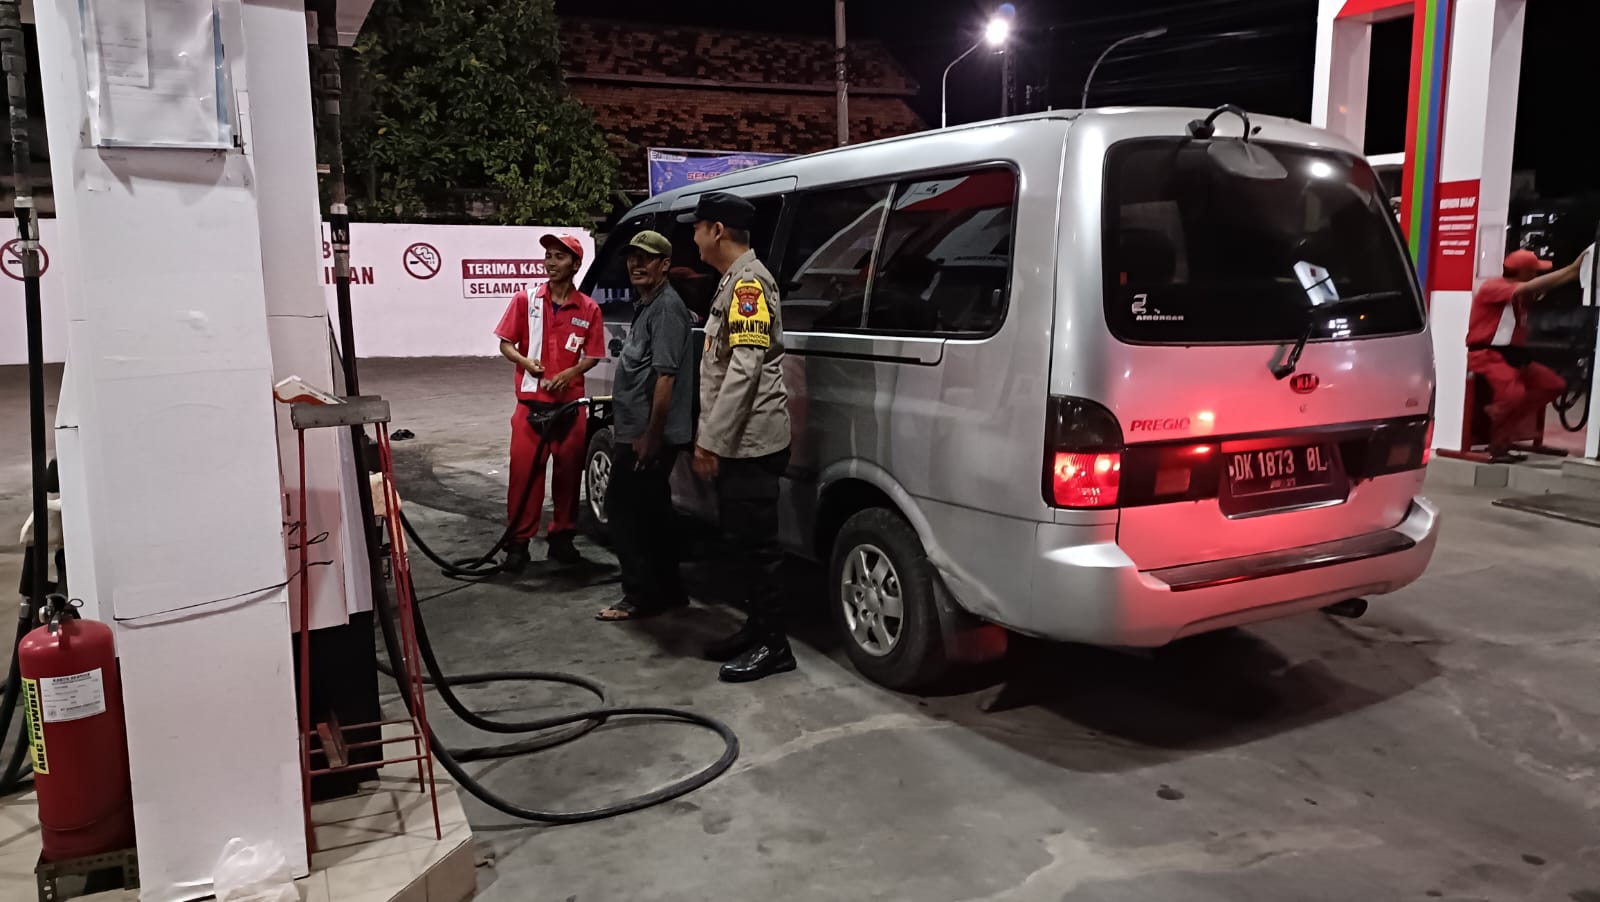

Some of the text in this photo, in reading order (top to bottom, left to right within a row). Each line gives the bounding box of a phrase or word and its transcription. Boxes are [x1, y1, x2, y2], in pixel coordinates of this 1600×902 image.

[467, 263, 517, 275] TERIMA
[1296, 375, 1317, 389] KIA
[1130, 418, 1191, 432] PREGIO
[1234, 454, 1254, 481] DK
[1258, 450, 1295, 478] 1873
[28, 683, 42, 740] POWDER
[36, 743, 47, 771] ABC
